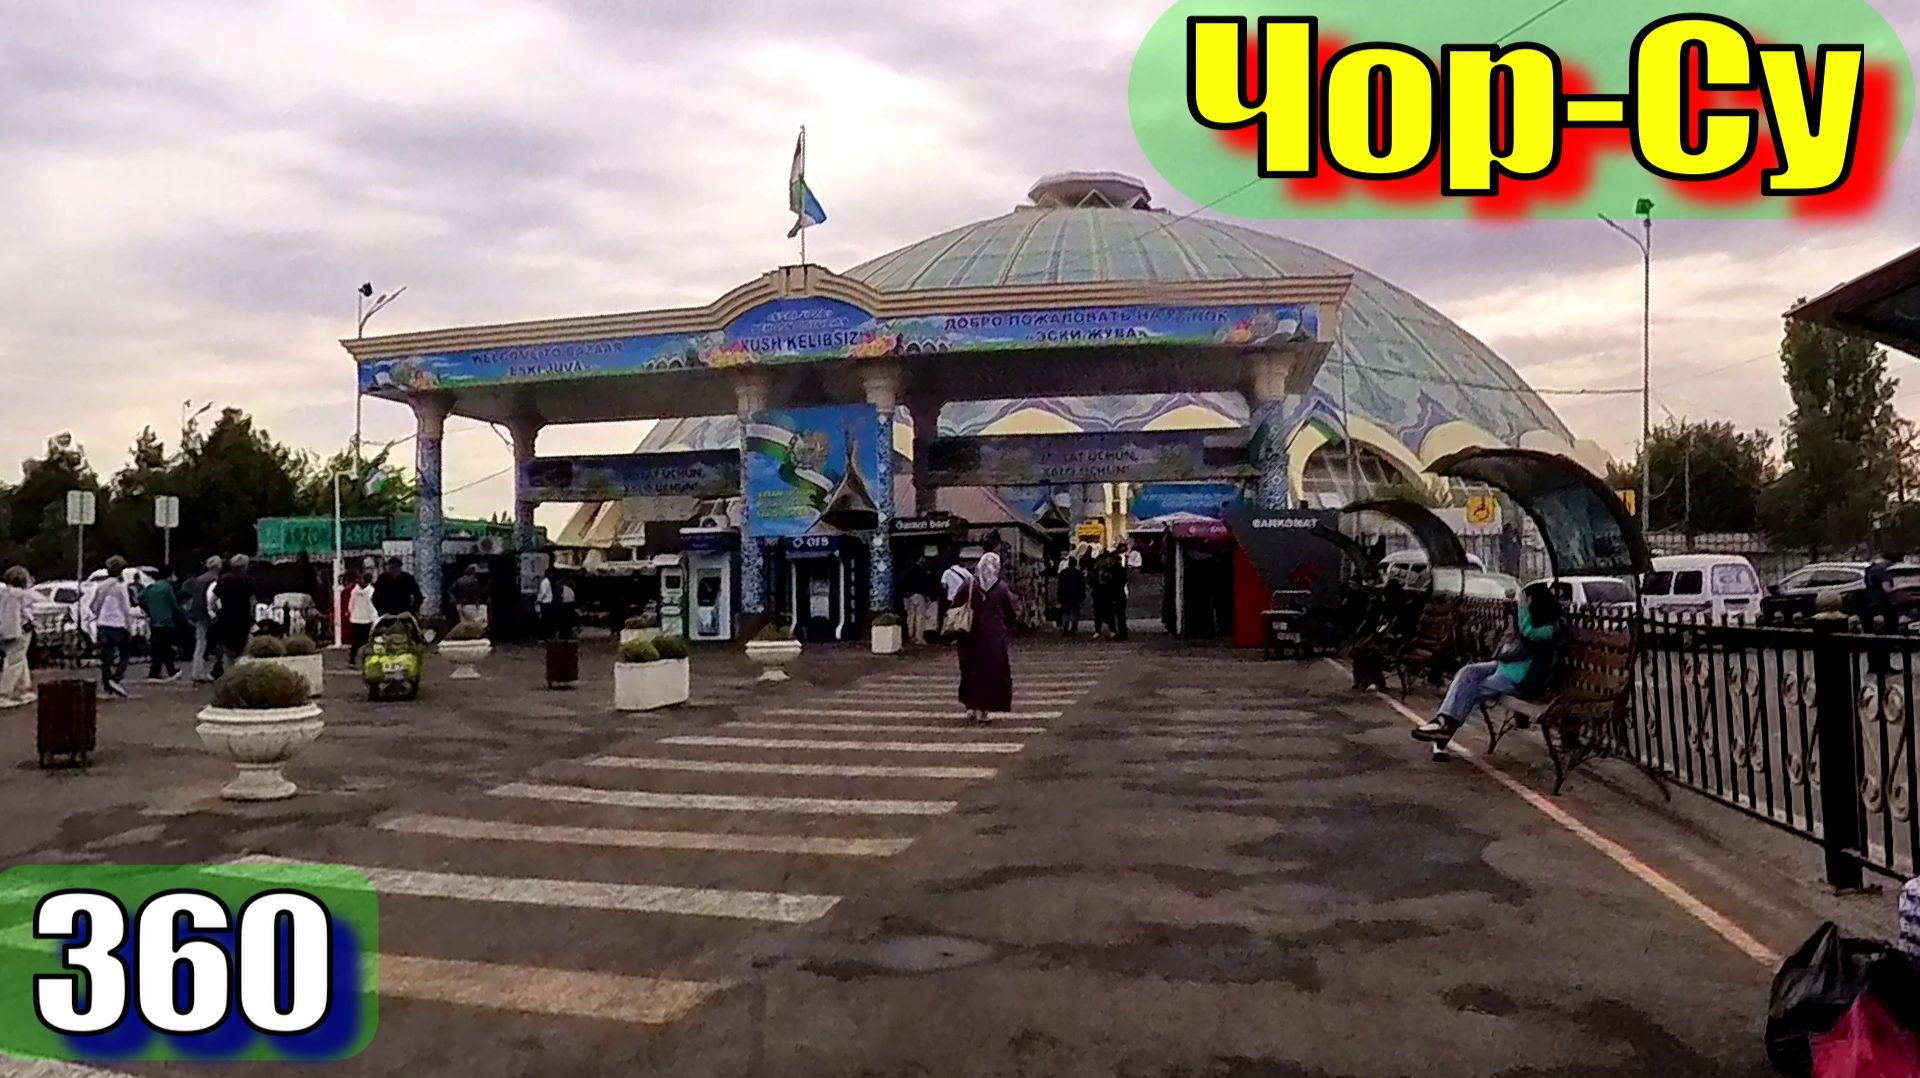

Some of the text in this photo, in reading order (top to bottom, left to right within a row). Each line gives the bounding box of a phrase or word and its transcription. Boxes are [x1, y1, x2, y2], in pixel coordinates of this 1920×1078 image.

[943, 315, 1003, 331] ДОБРО
[1008, 308, 1131, 327] ПОЖАЛОВАТЬ
[1251, 517, 1319, 530] BANKOMAT
